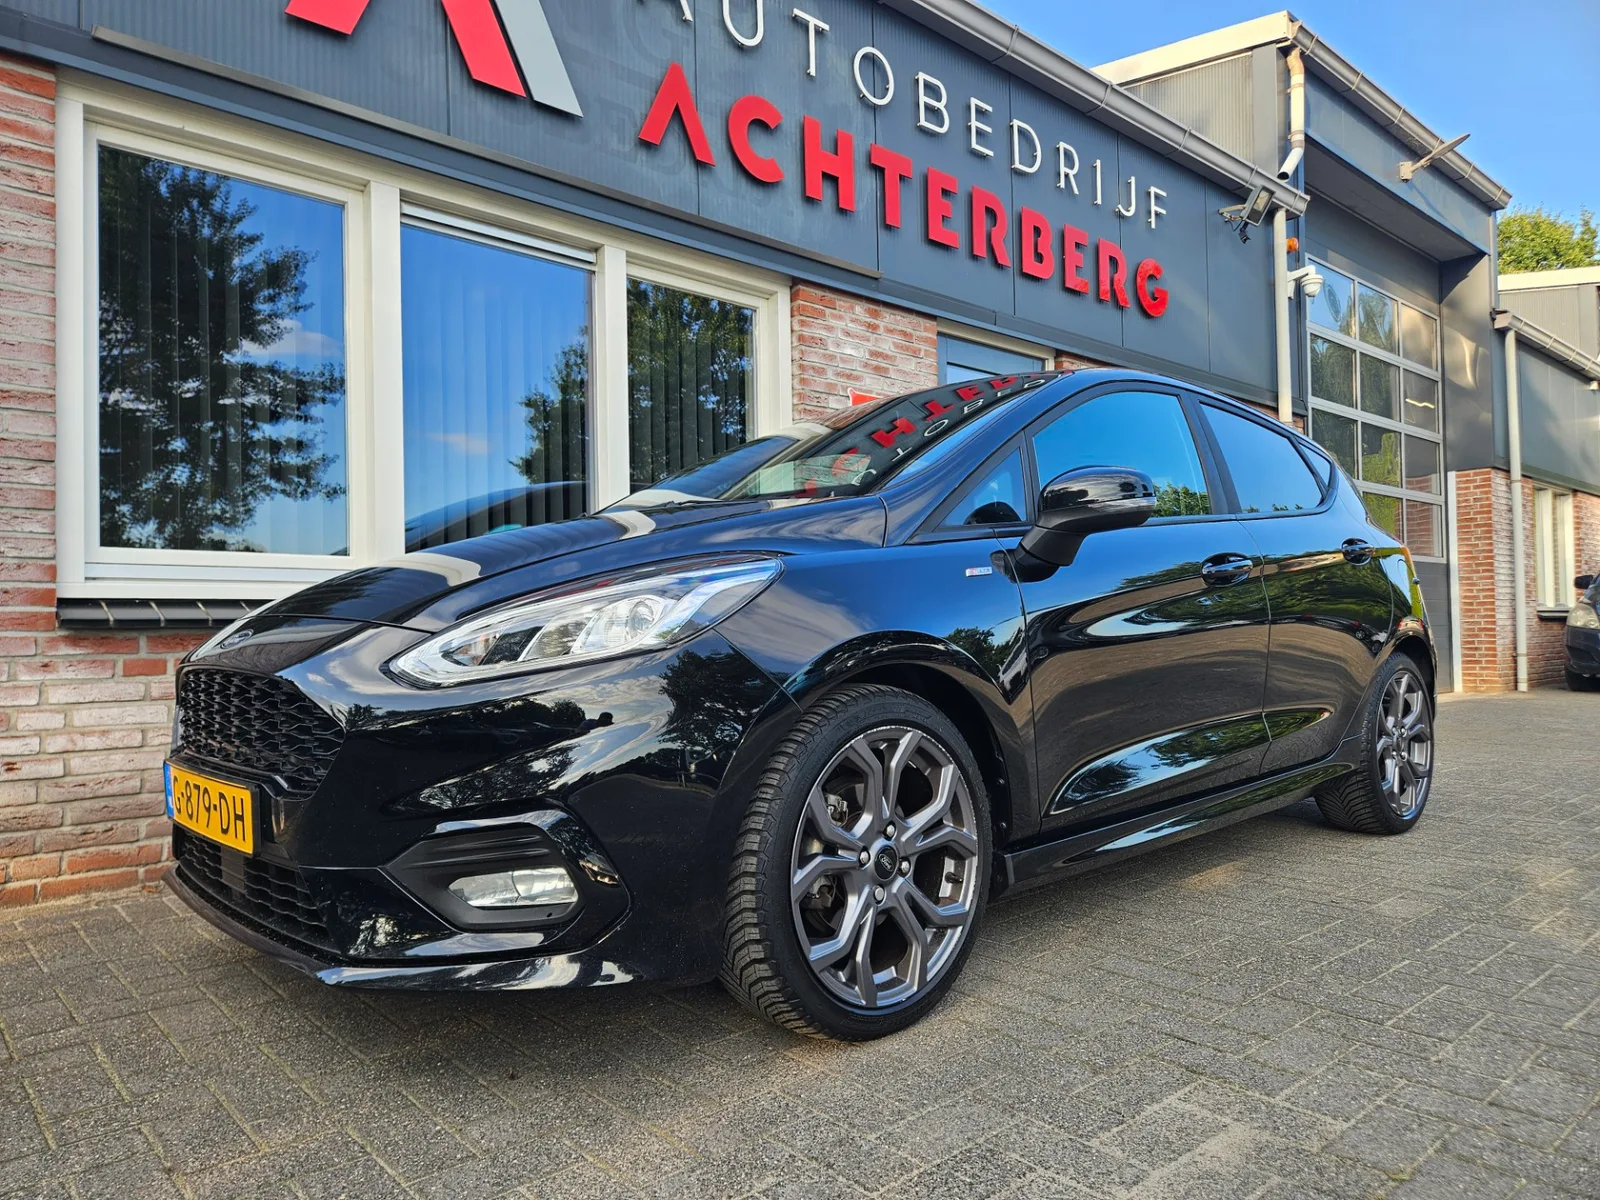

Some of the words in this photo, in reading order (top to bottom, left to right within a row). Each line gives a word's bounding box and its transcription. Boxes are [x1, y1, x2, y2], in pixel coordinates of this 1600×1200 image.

[638, 0, 1168, 229] UTOBEDRIJF
[639, 62, 1169, 318] ACHTERBERG
[173, 775, 246, 842] G-879-DH
